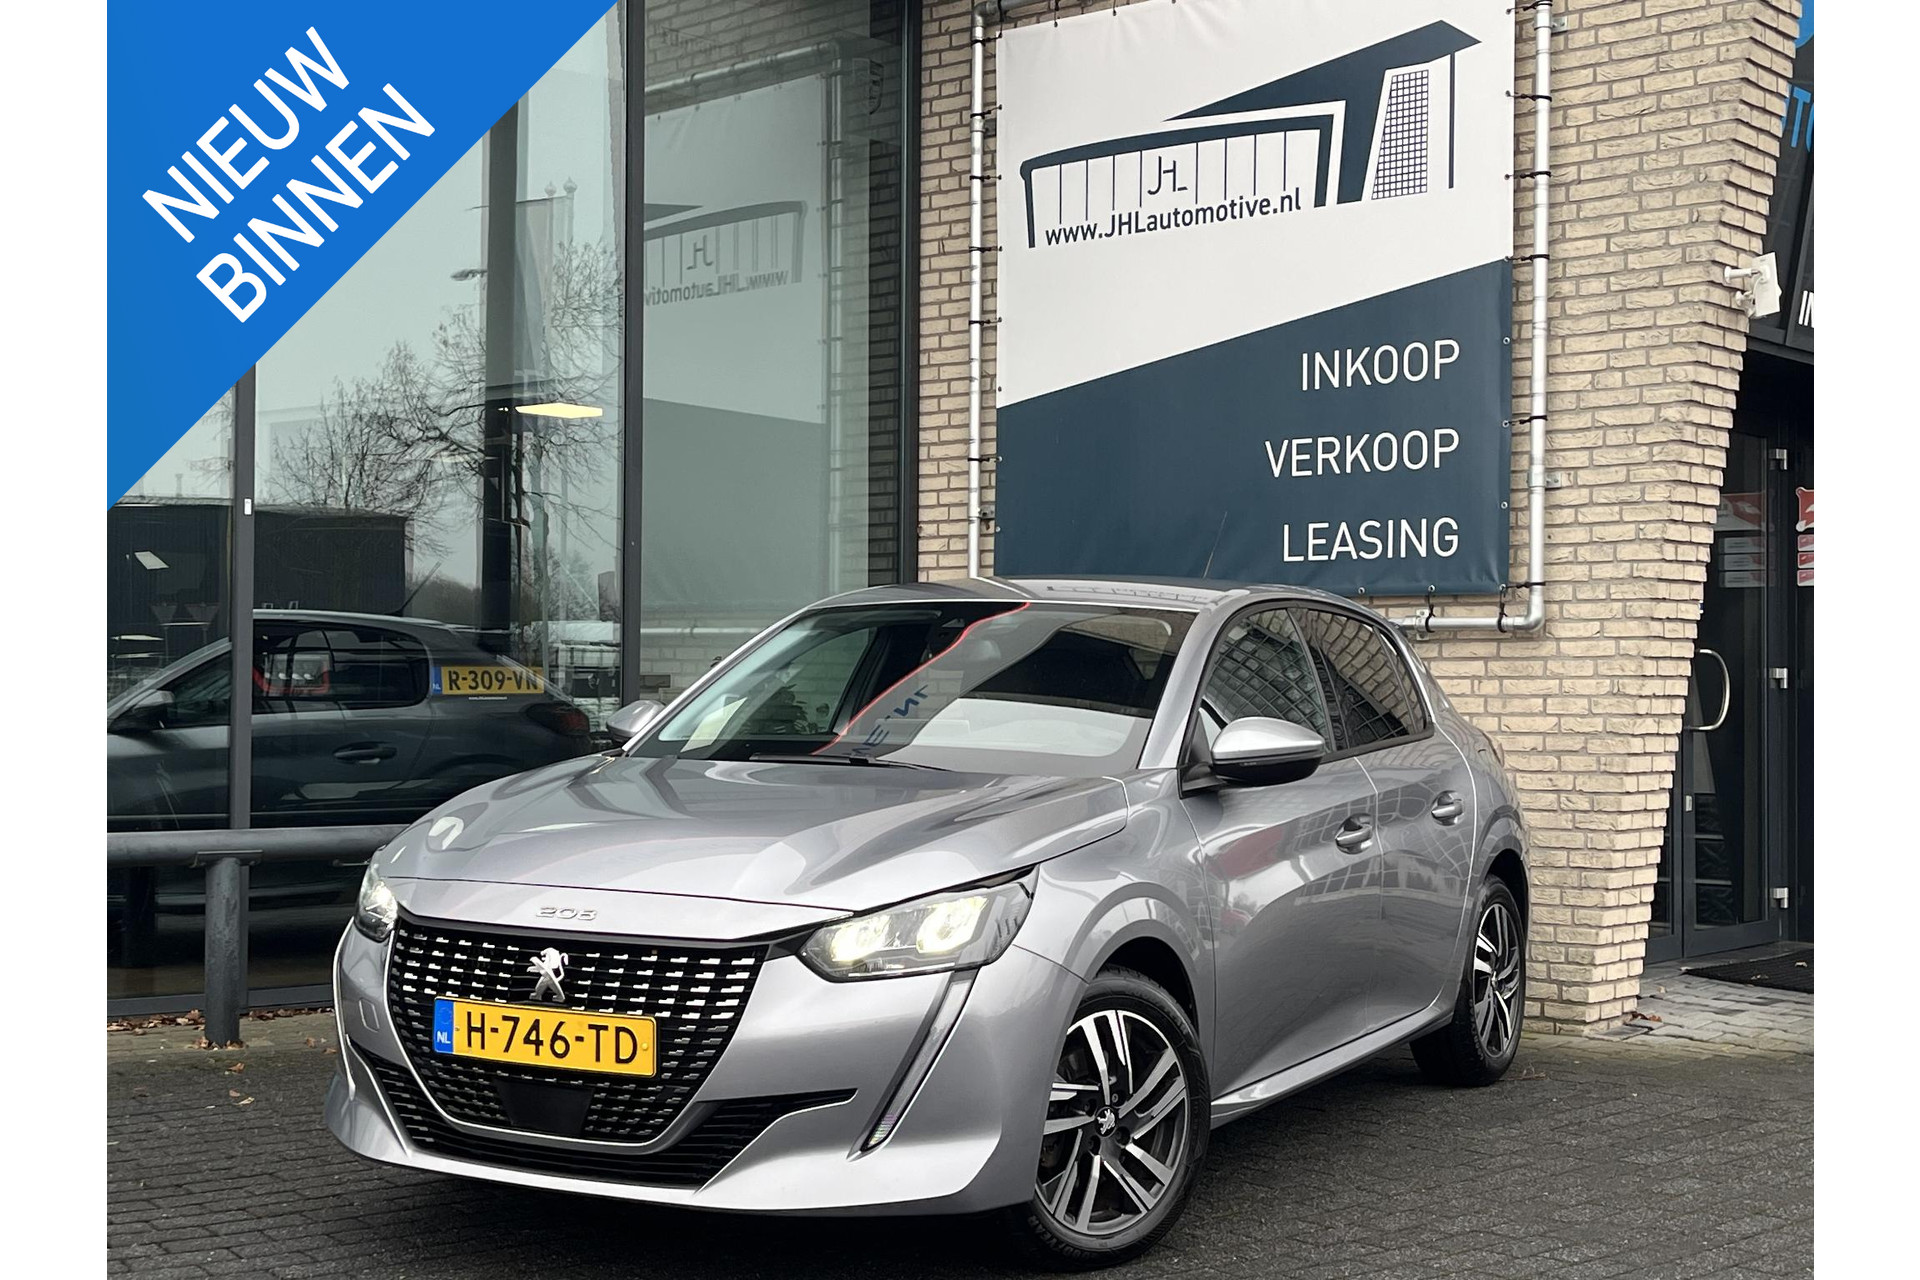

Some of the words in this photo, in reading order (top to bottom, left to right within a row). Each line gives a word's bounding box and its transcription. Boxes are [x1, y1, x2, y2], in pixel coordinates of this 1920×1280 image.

[1147, 155, 1188, 196] JHL
[1046, 186, 1302, 246] www.JHLautomotive.nl
[1302, 340, 1460, 391] INKOOP
[1264, 428, 1460, 478] VERKOOP
[1283, 517, 1459, 562] LEASING
[448, 670, 538, 691] R-309-VN
[536, 906, 597, 921] 208
[436, 1031, 451, 1044] NL
[466, 1011, 638, 1064] H-746-TD
